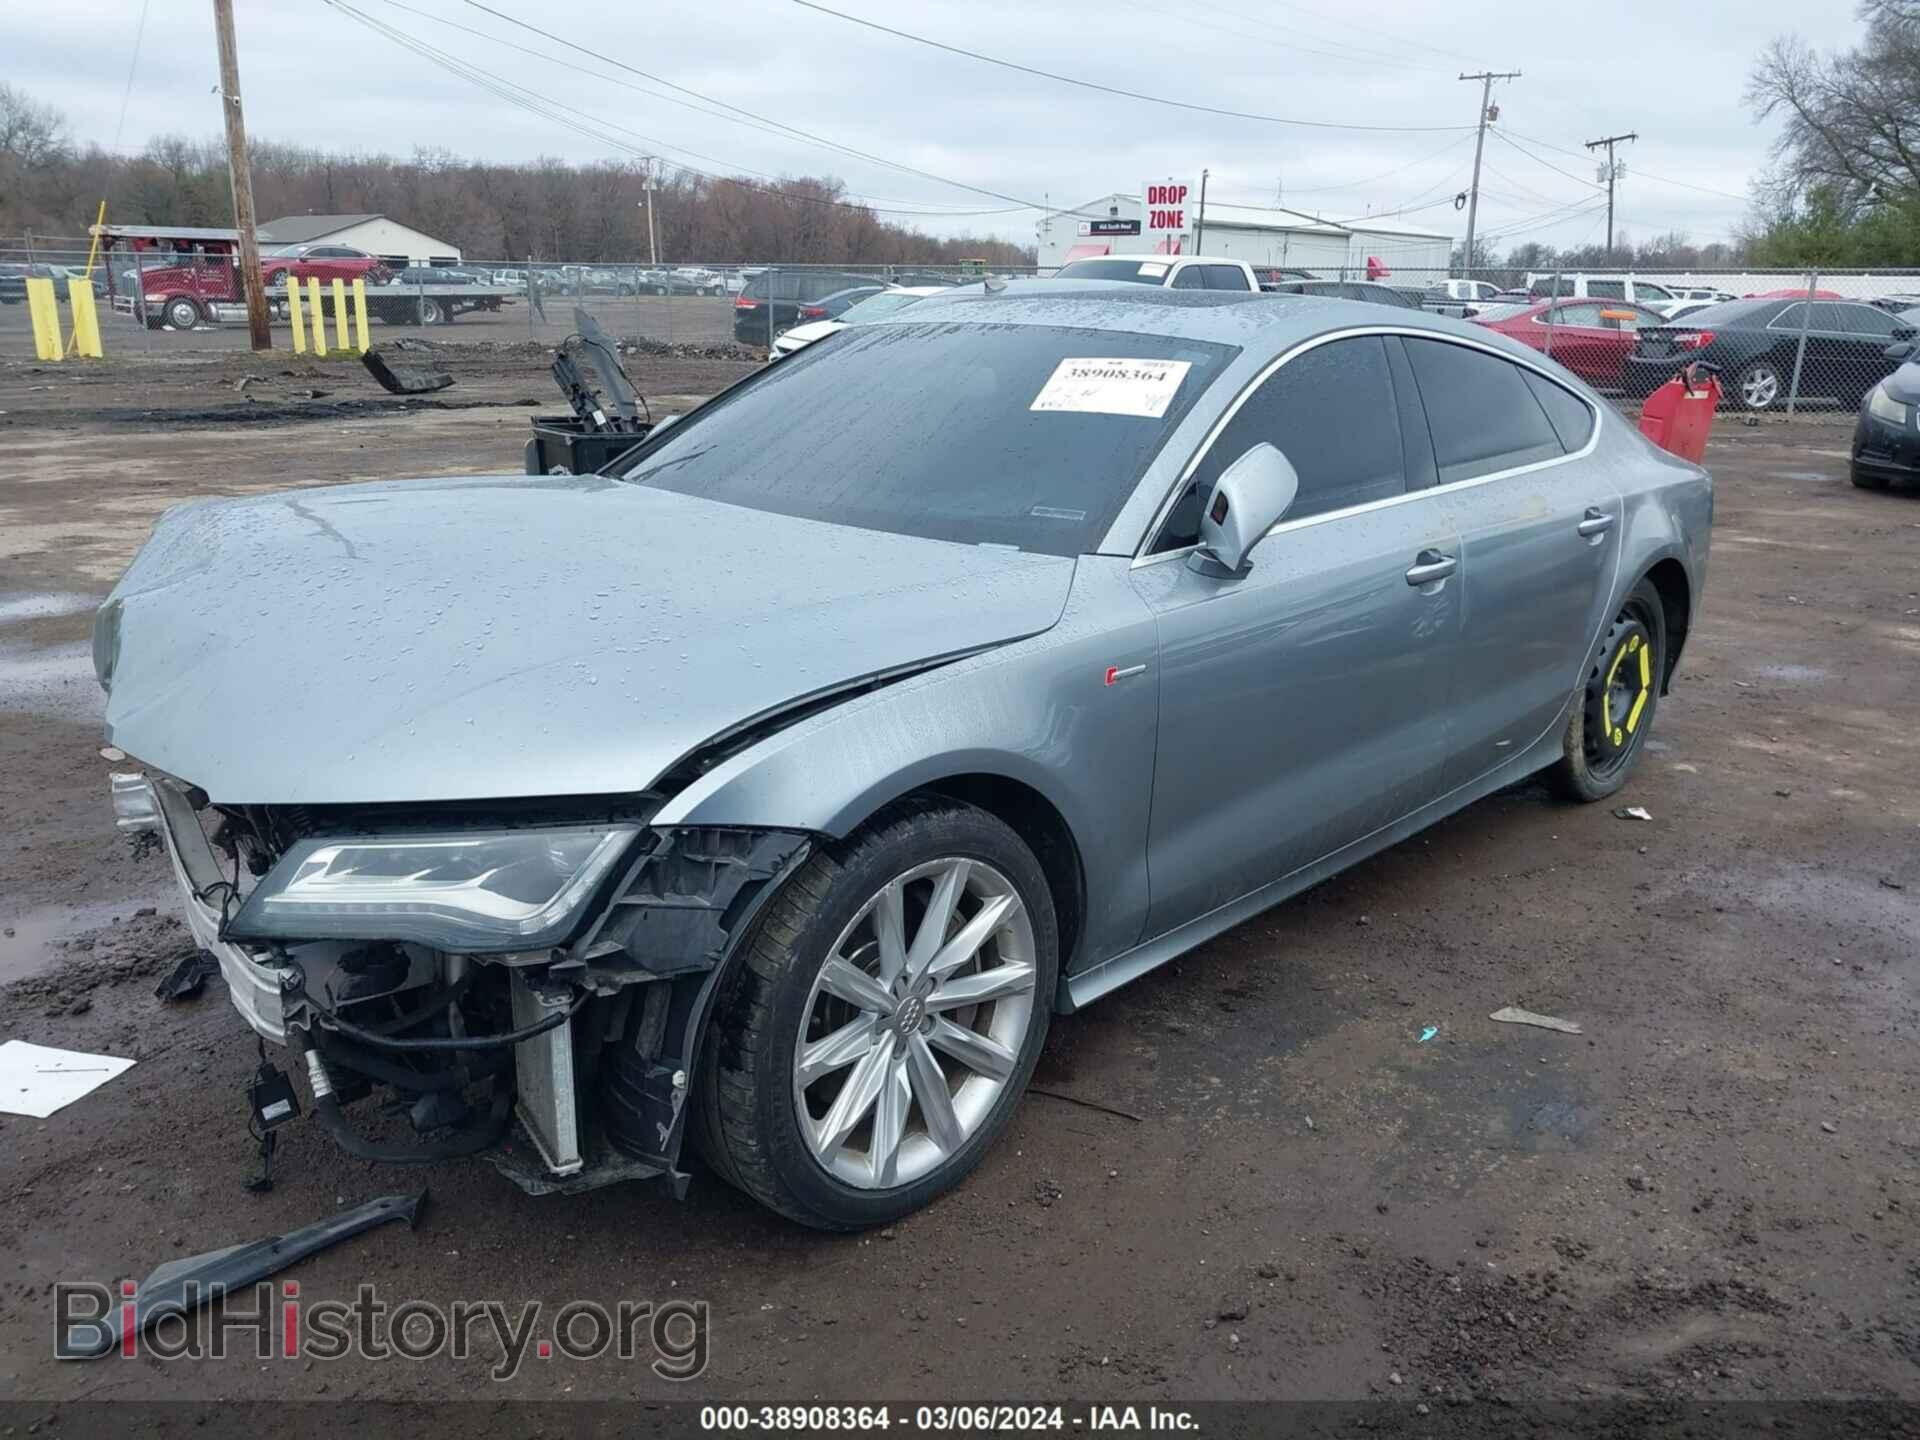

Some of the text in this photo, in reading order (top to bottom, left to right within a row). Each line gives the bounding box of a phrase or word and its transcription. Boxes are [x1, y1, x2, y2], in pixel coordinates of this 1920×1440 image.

[1148, 186, 1188, 205] DROP
[1149, 210, 1185, 229] ZONE
[1065, 367, 1168, 382] 38908364
